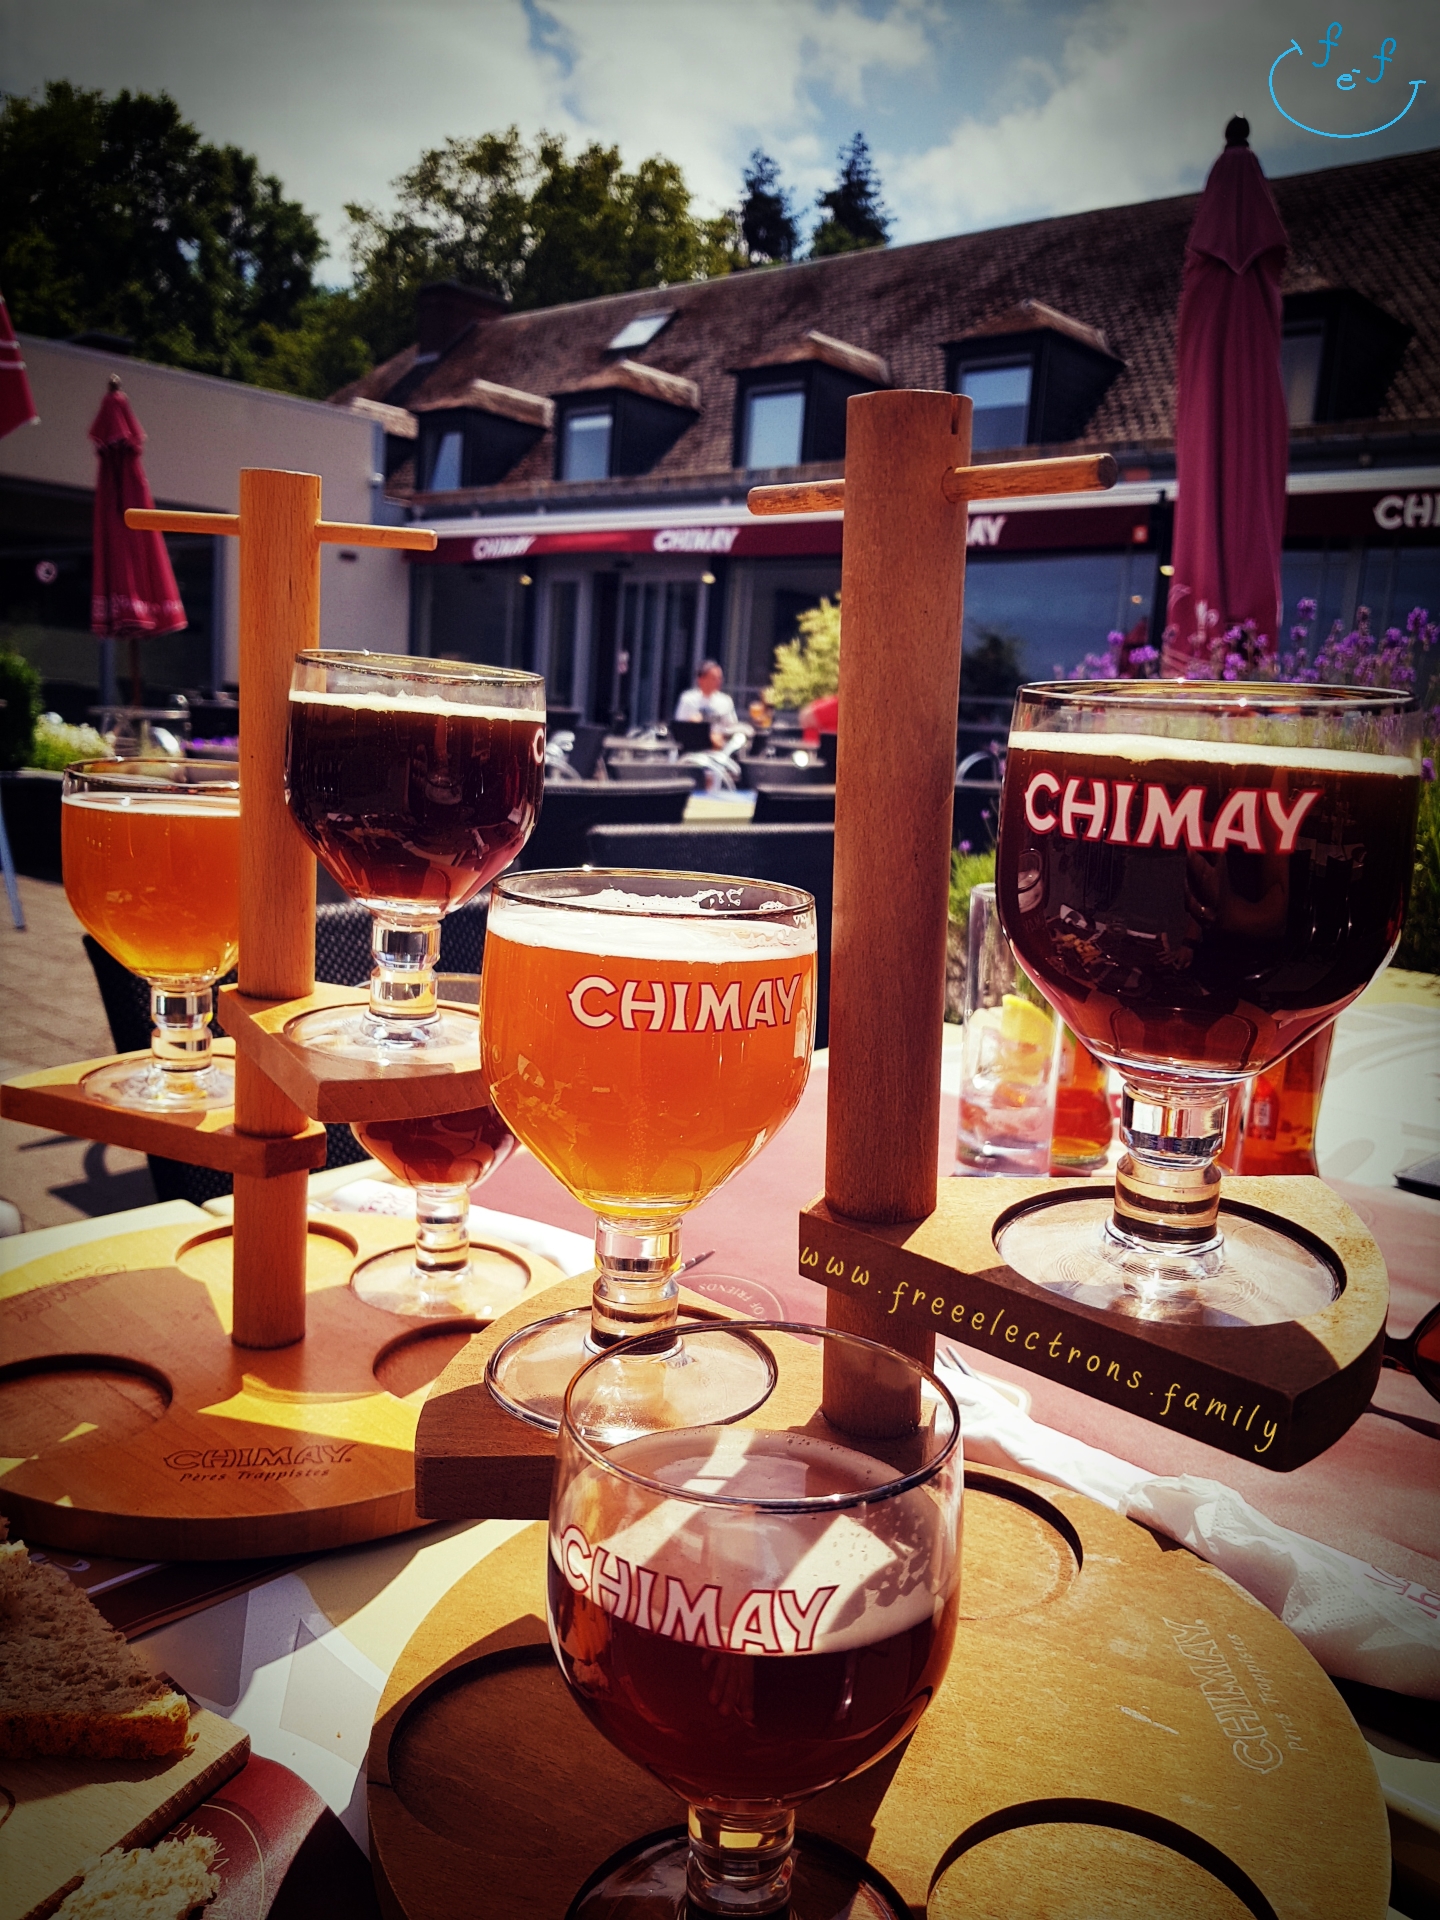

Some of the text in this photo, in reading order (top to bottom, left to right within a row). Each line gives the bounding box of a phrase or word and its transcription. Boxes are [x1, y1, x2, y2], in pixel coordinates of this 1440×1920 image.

[1024, 770, 1324, 854] CHIMAY
[566, 972, 803, 1033] CHIMAY
[561, 1524, 840, 1653] CHIMAY
